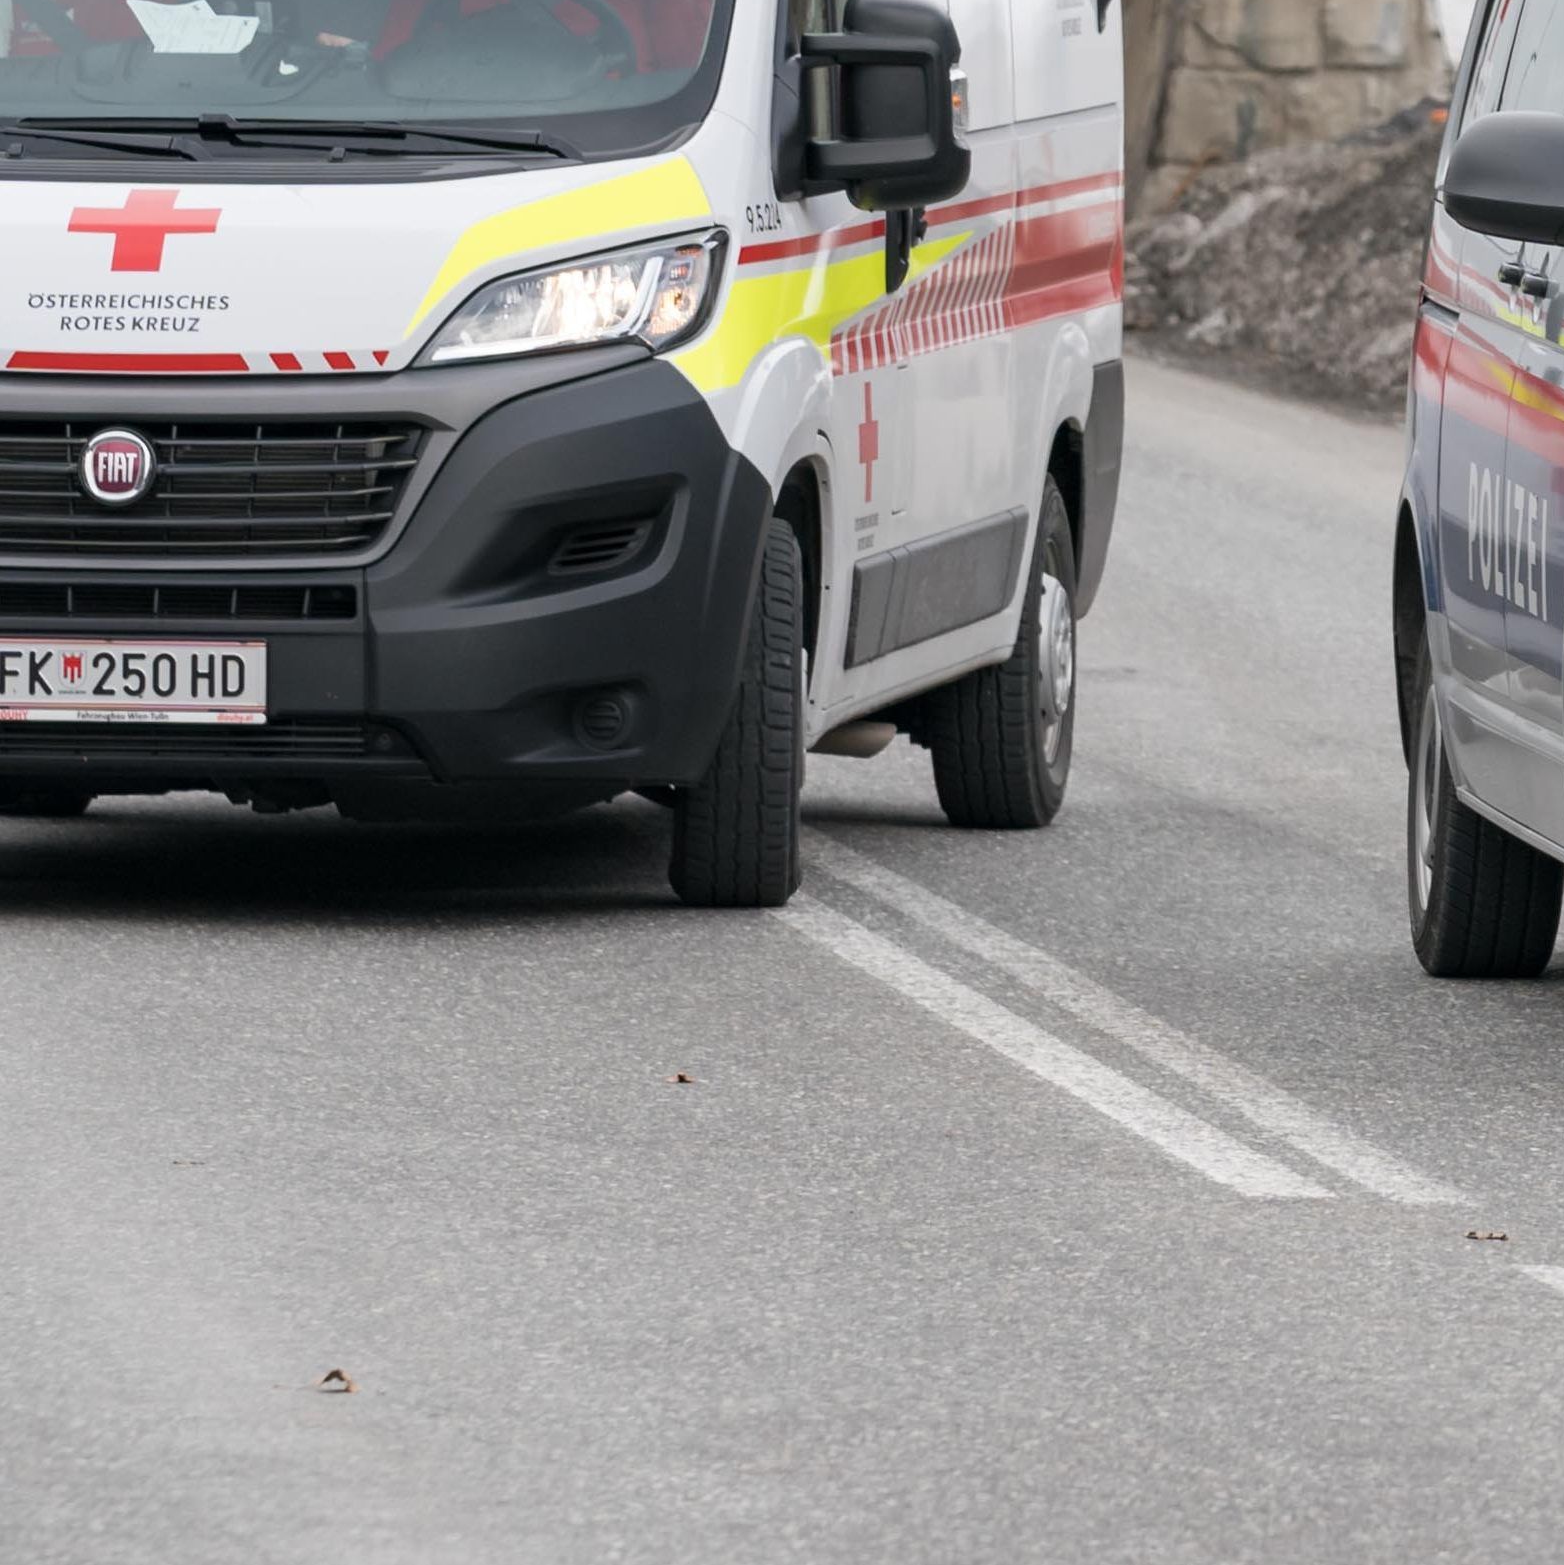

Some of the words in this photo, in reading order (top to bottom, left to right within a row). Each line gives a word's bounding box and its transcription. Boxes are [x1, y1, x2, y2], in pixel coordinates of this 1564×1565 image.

[28, 292, 230, 311] ÖSTERREICHISCHES
[60, 316, 126, 331] ROTES
[131, 317, 201, 332] KREUZ
[97, 451, 138, 483] FIAT
[1467, 461, 1548, 623] POLIZEI
[0, 651, 52, 696] FK
[92, 652, 176, 698] 250
[191, 653, 245, 698] HD
